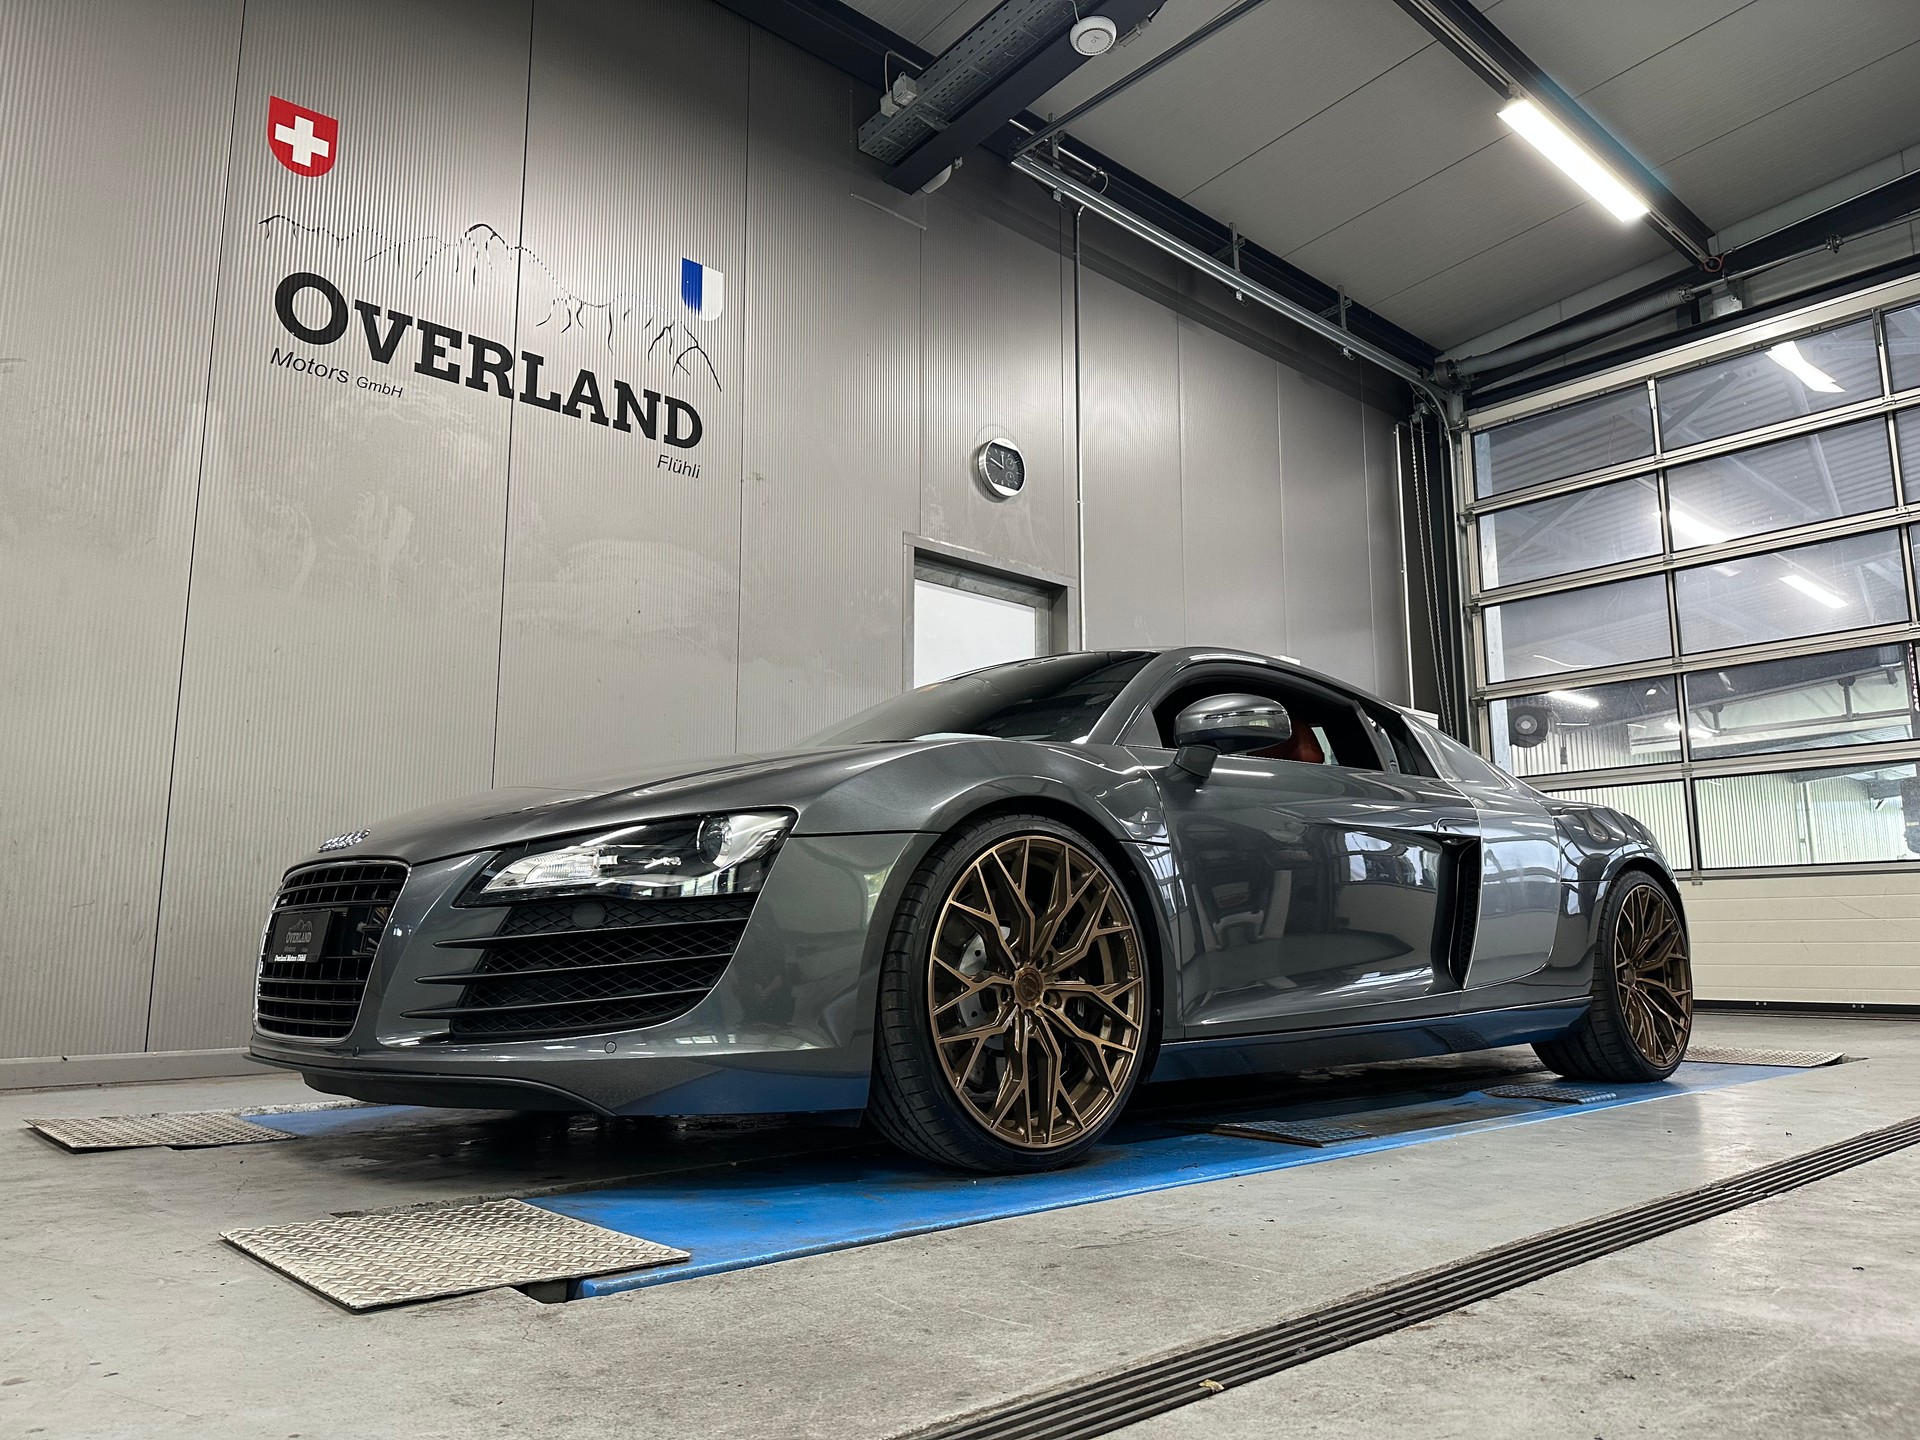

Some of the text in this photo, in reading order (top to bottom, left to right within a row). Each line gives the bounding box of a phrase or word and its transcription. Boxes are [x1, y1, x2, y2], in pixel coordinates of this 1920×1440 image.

[270, 347, 404, 398] Motors GmbH
[275, 272, 703, 449] OVERLAND
[657, 454, 701, 479] Flühli
